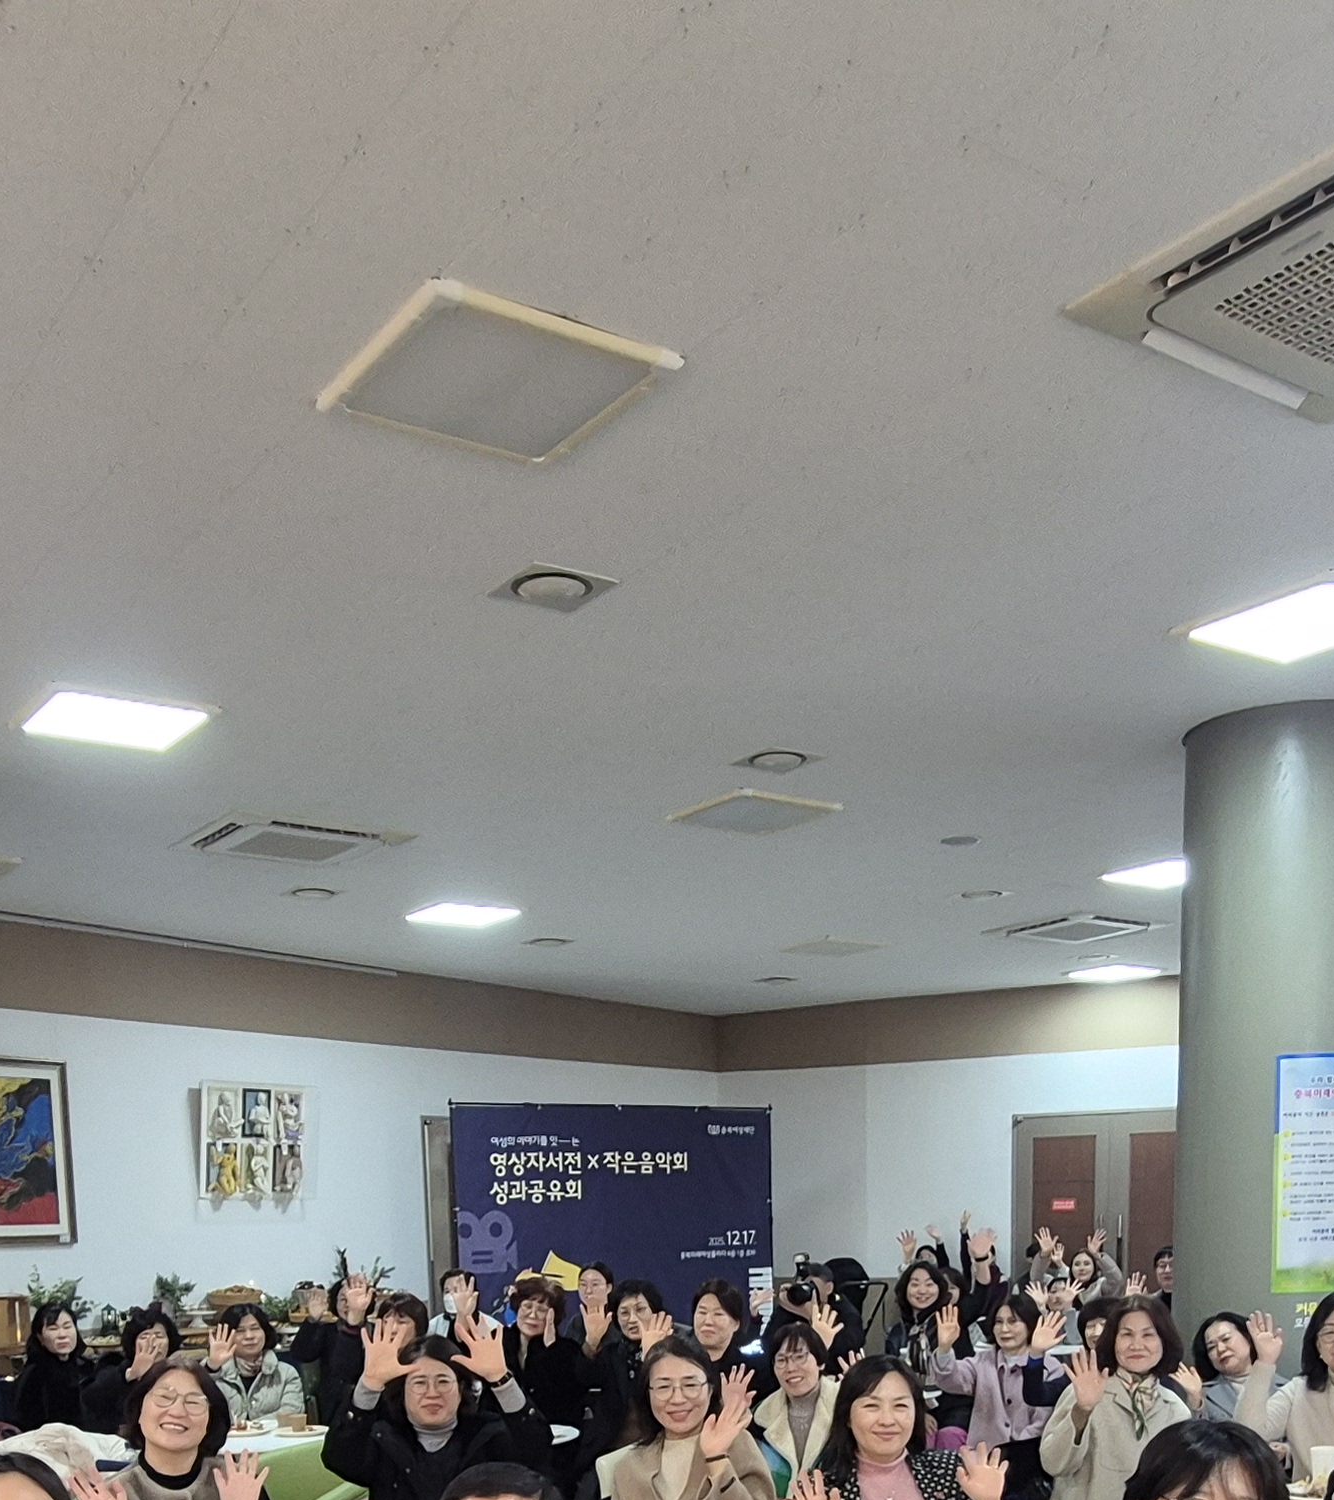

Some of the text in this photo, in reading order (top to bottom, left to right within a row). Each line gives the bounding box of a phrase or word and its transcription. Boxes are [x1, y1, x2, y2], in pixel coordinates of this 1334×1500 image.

[490, 1136, 516, 1148] 여성의
[516, 1135, 548, 1147] 이야기를
[489, 1151, 582, 1176] 영상자서전
[602, 1151, 688, 1175] 작은음악회
[489, 1179, 582, 1205] 성과공유회
